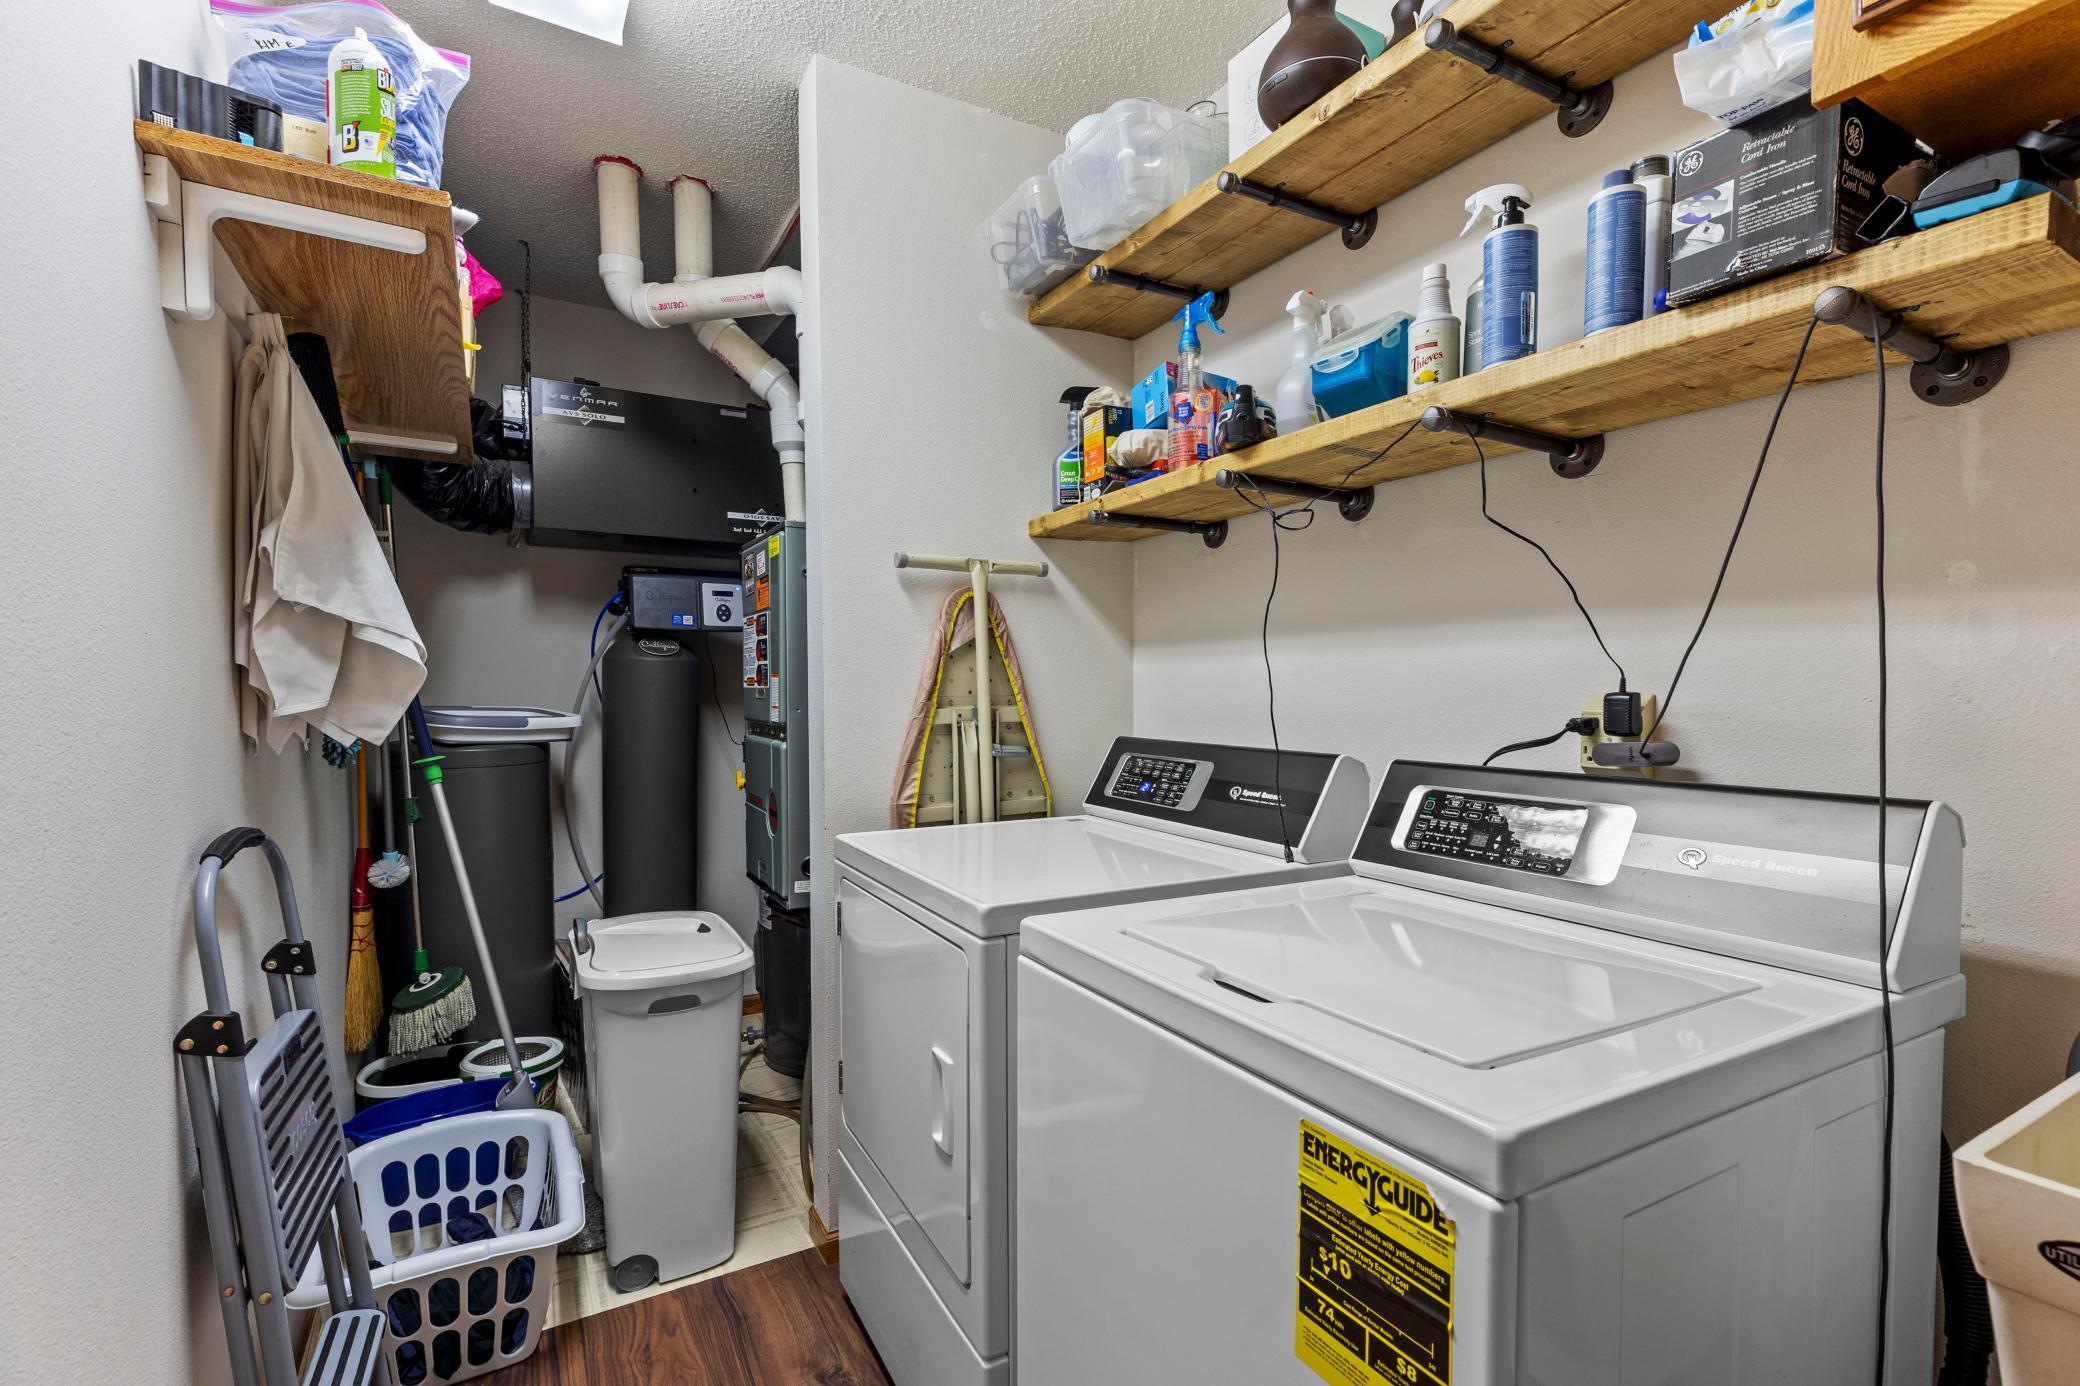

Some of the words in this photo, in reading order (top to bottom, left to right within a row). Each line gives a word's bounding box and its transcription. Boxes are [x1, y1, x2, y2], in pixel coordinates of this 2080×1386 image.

[1742, 124, 1796, 152] Retractable
[1741, 147, 1764, 164] Cord
[1766, 140, 1786, 154] Iron
[1842, 159, 1877, 185] Retractable
[1841, 174, 1857, 192] Cord
[1857, 182, 1871, 199] Iron
[1411, 351, 1443, 373] Thieves
[581, 412, 607, 420] SOLO
[641, 640, 678, 651] Culligan
[1242, 788, 1261, 797] Speed
[1712, 853, 1761, 868] Speed
[1765, 860, 1818, 877] Queen
[1303, 1130, 1449, 1237] ENERGYGUIDE
[1326, 1202, 1340, 1217] ONLY
[1348, 1217, 1362, 1232] other
[1364, 1227, 1380, 1243] labels
[1382, 1239, 1394, 1253] with
[1395, 1247, 1414, 1266] yellow
[1416, 1260, 1446, 1285] numbers.
[1327, 1213, 1339, 1226] yellow
[1365, 1237, 1377, 1250] based
[1392, 1256, 1403, 1267] same
[1404, 1262, 1413, 1274] test
[1414, 1269, 1441, 1292] procedures.
[1319, 1246, 1352, 1279] $10
[1331, 1233, 1356, 1256] Estimated
[1358, 1251, 1373, 1268] Yearly
[1375, 1262, 1393, 1282] Energy
[1396, 1276, 1408, 1291] Cost
[1304, 1305, 1321, 1323] Estimated
[1322, 1319, 1332, 1332] Yearly
[1317, 1298, 1334, 1323] 74
[1397, 1357, 1417, 1382] $8
